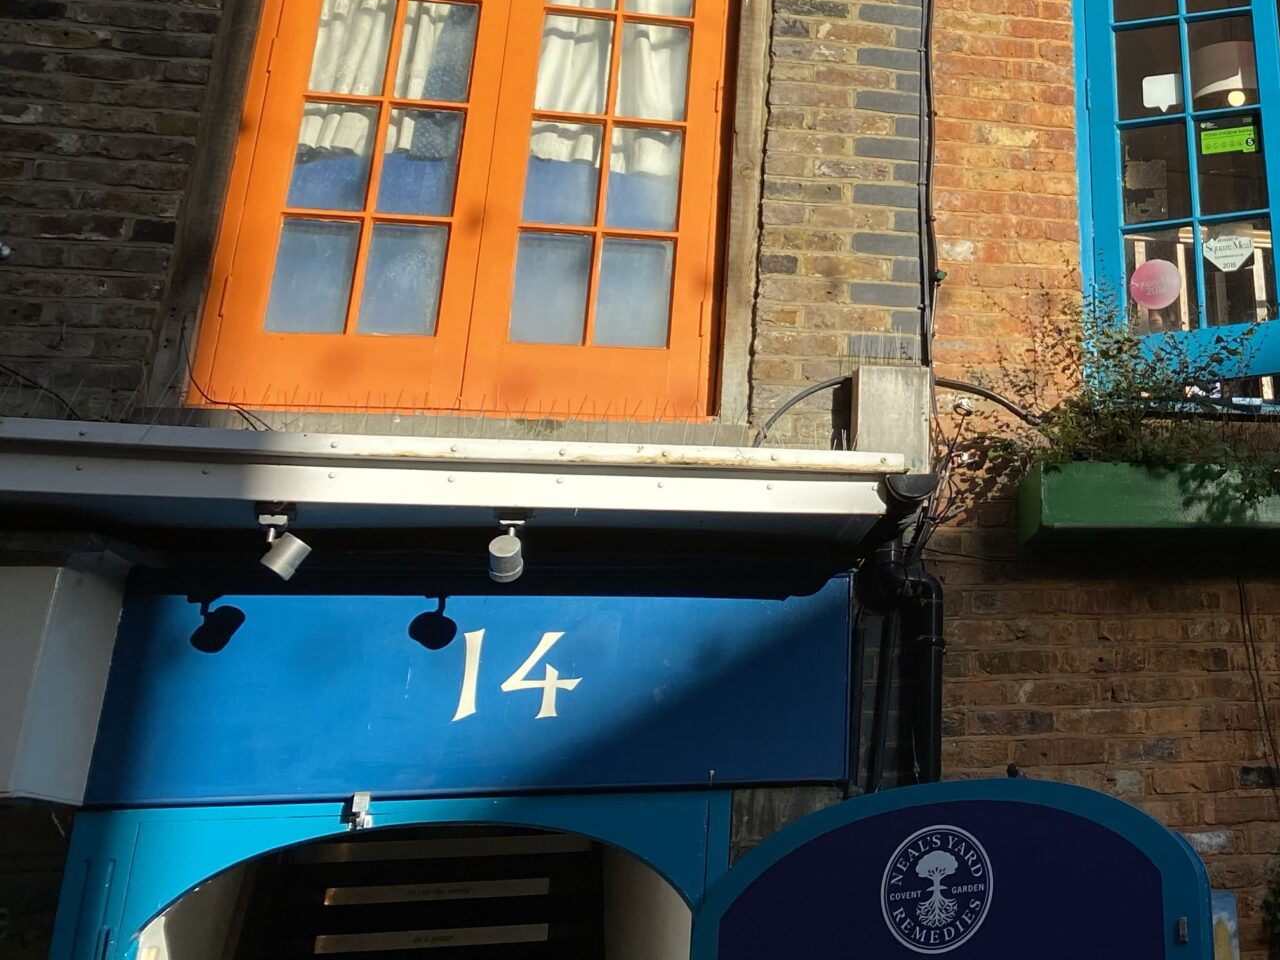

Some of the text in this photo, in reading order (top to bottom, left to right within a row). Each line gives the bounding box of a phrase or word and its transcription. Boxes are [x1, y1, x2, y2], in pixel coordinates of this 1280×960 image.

[452, 628, 583, 722] 14
[890, 834, 983, 886] NEAL'S YARD
[890, 883, 985, 901] COVENT GARDEN
[893, 898, 981, 944] REMEDIES
